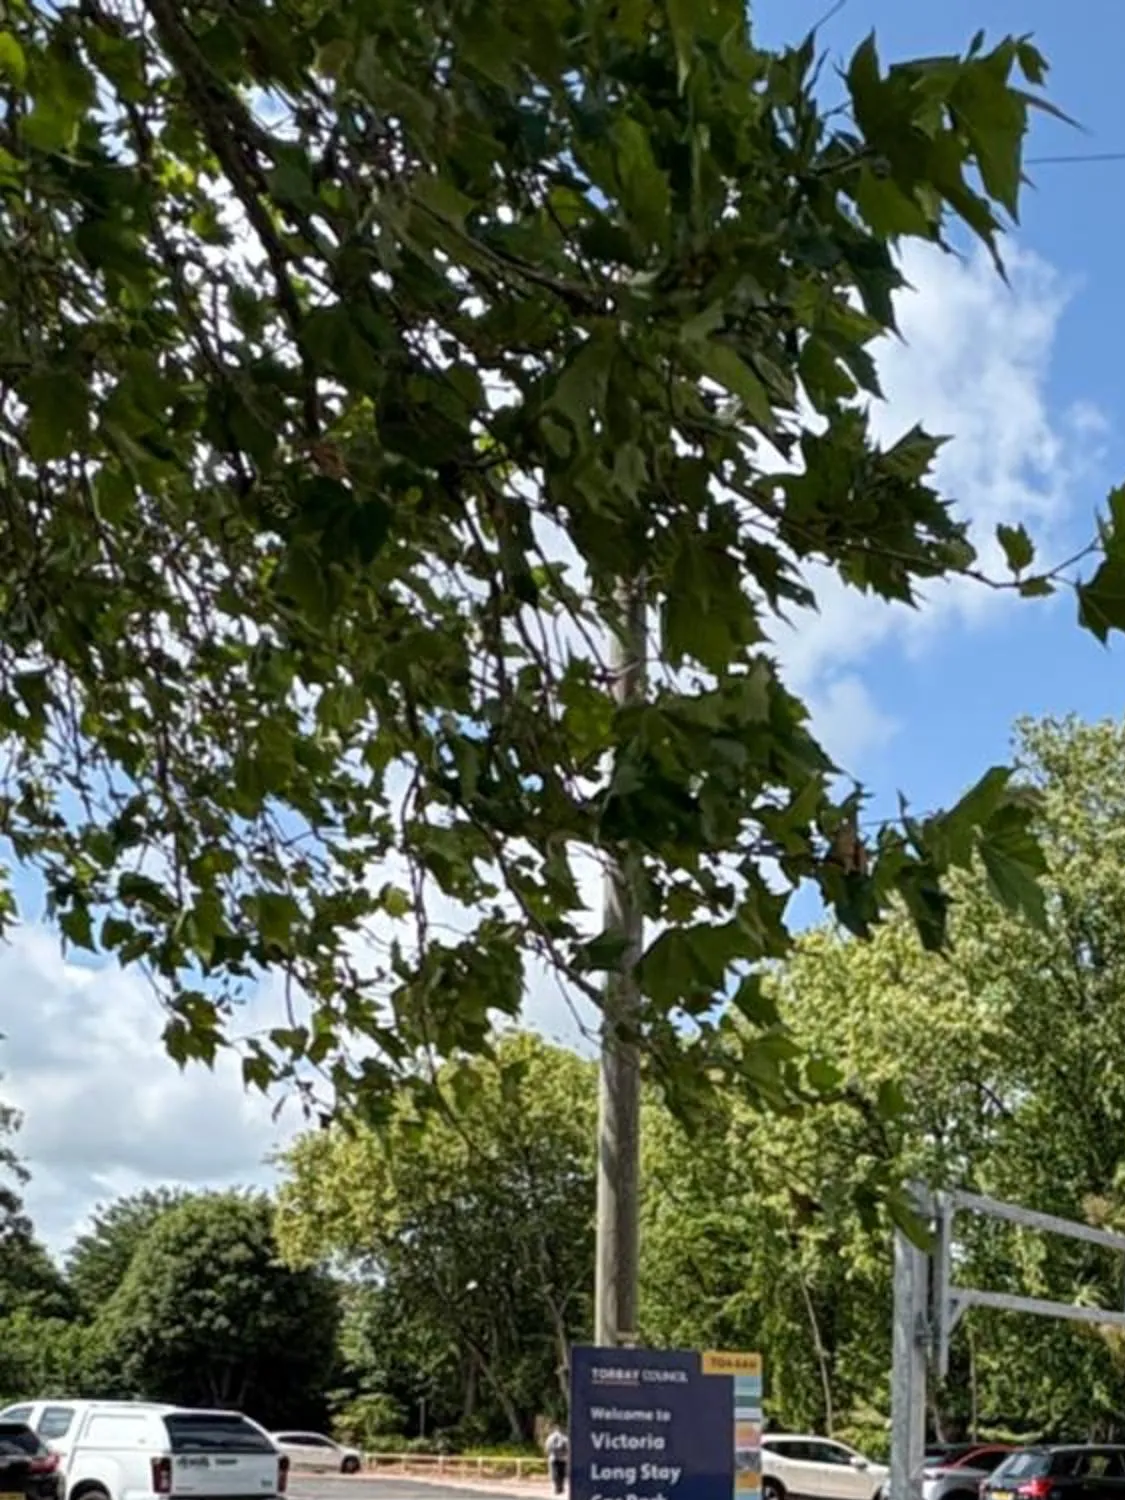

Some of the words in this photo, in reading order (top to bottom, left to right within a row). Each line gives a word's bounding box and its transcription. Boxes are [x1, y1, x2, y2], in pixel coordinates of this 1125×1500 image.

[592, 1368, 640, 1380] TORBAY
[642, 1369, 689, 1382] COUNCIL
[590, 1407, 653, 1421] Welcome
[656, 1408, 671, 1422] to
[591, 1432, 666, 1450] Victoria
[591, 1463, 637, 1486] Long
[640, 1463, 682, 1486] Stay
